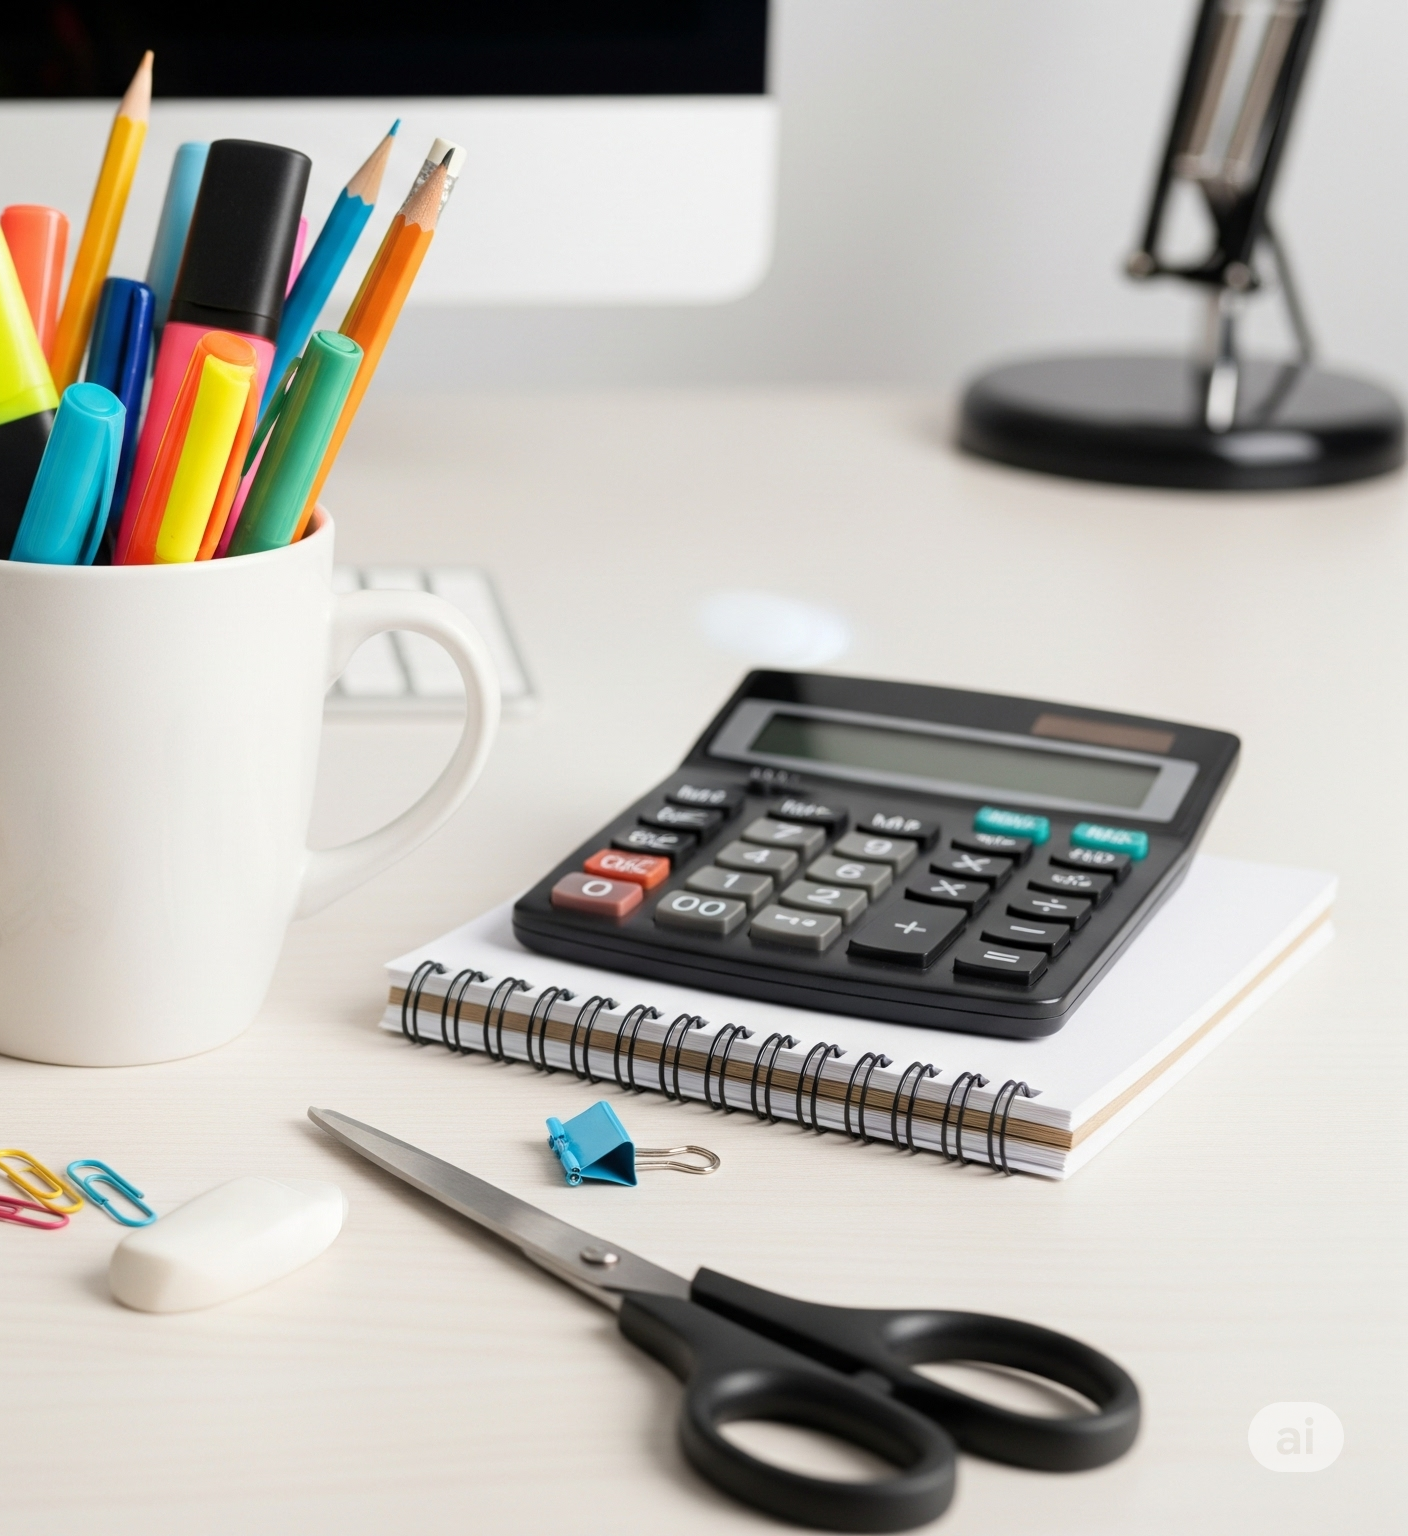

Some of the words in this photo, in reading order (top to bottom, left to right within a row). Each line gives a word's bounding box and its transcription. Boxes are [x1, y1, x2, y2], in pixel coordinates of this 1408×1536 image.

[773, 824, 804, 839] 7
[864, 839, 893, 855] 9
[743, 850, 771, 864] 4
[835, 863, 865, 879] 6
[581, 880, 613, 897] 0
[723, 873, 741, 889] 1
[806, 888, 841, 905] 2
[671, 895, 727, 916] 00
